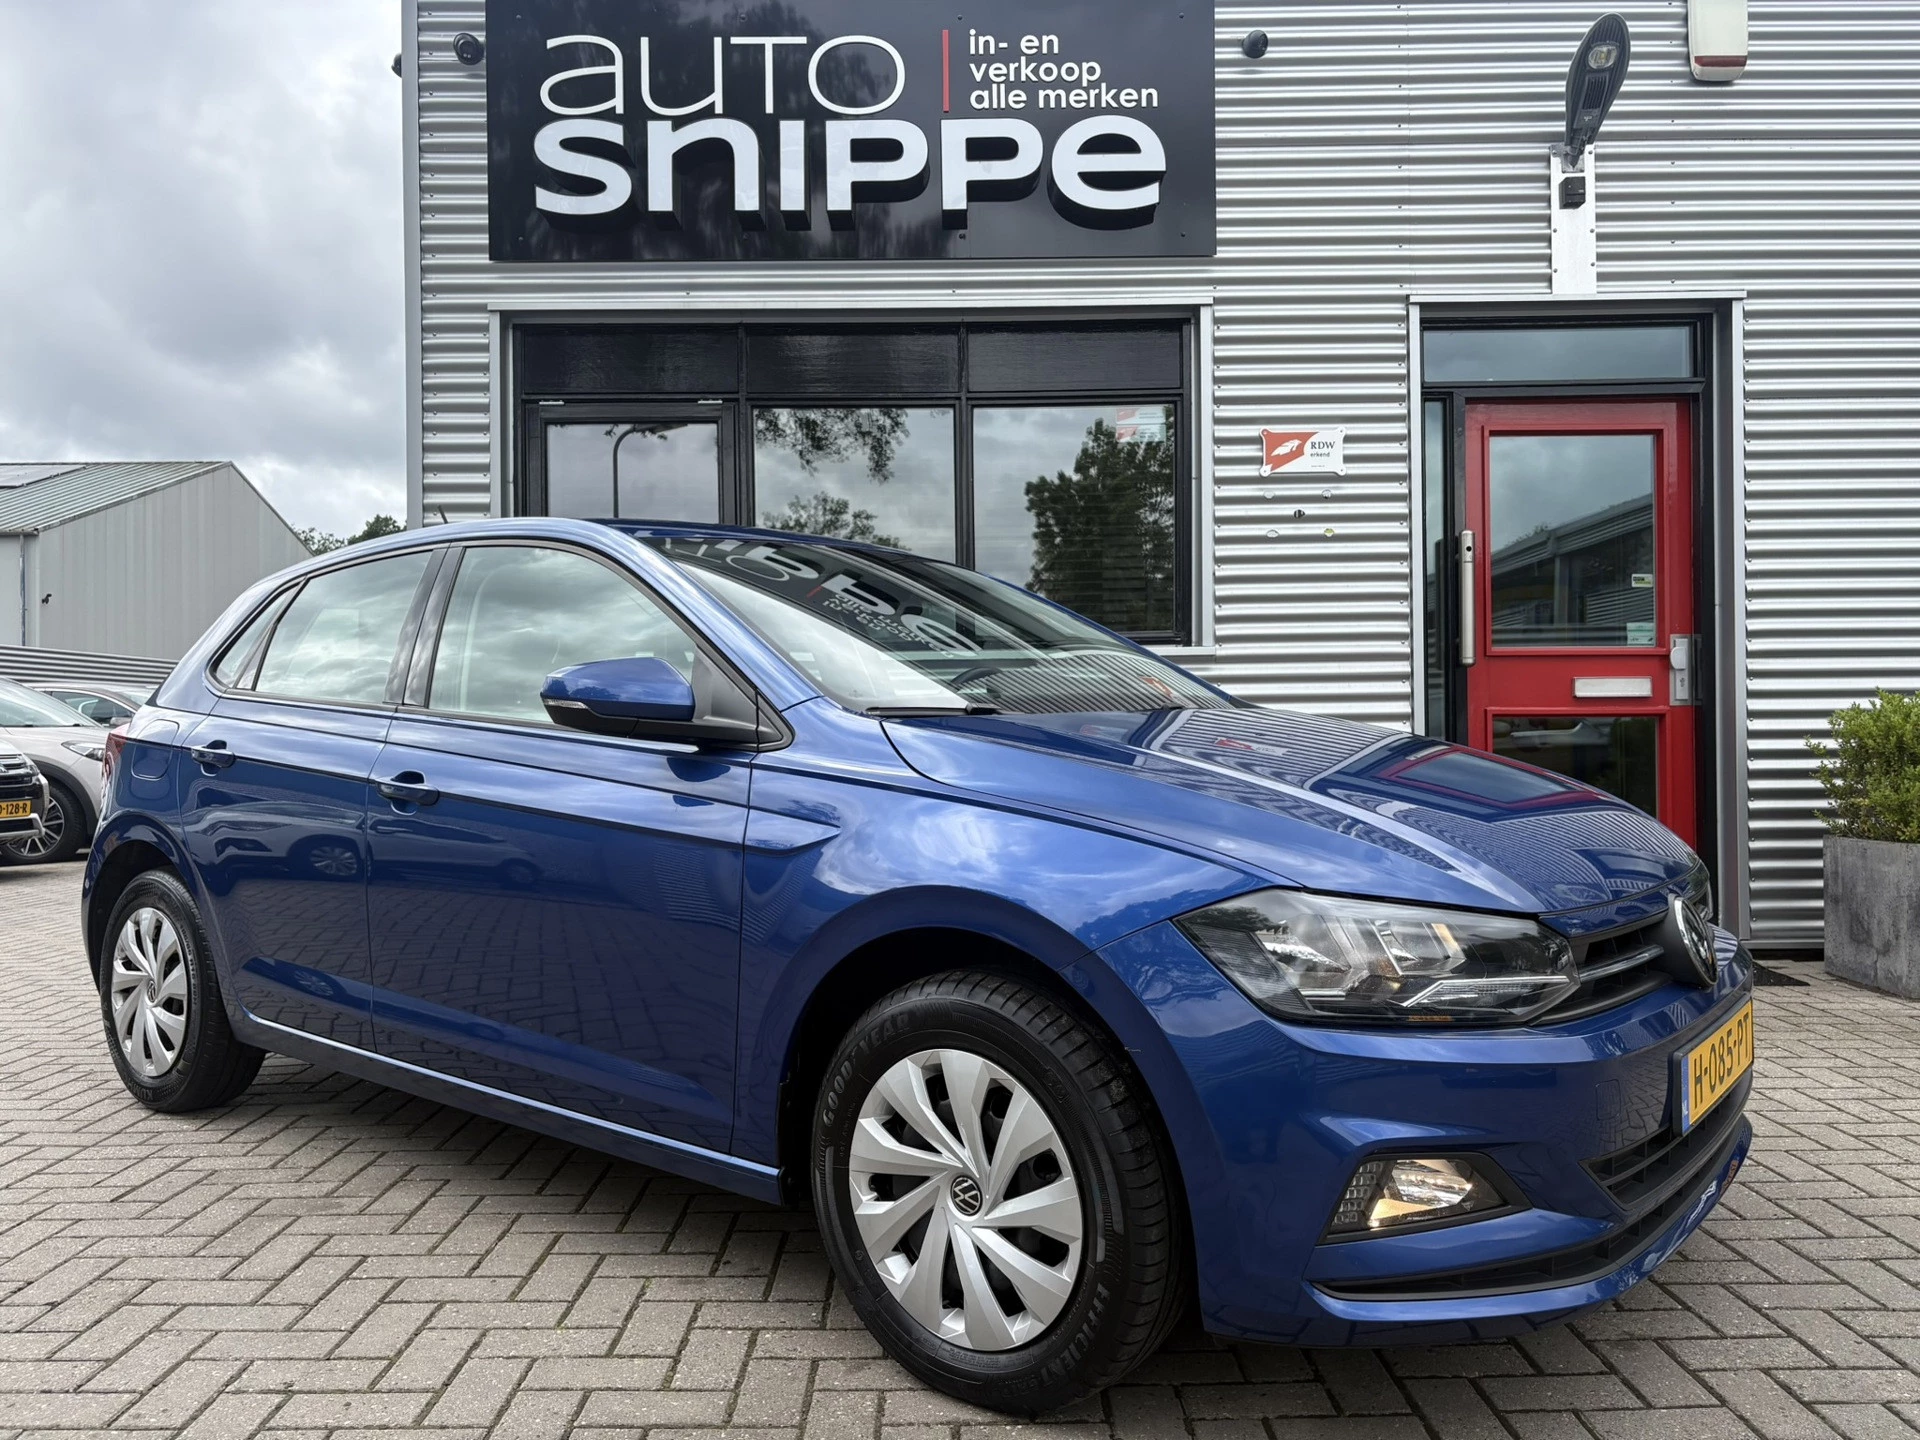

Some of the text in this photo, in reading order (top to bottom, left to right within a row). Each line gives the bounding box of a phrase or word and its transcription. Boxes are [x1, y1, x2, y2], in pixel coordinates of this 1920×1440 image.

[969, 28, 1059, 55] in- en
[969, 56, 1101, 87] verkoop
[969, 83, 1159, 109] alle merken
[1310, 441, 1335, 450] RDW
[1693, 1012, 1749, 1110] H-085-PT
